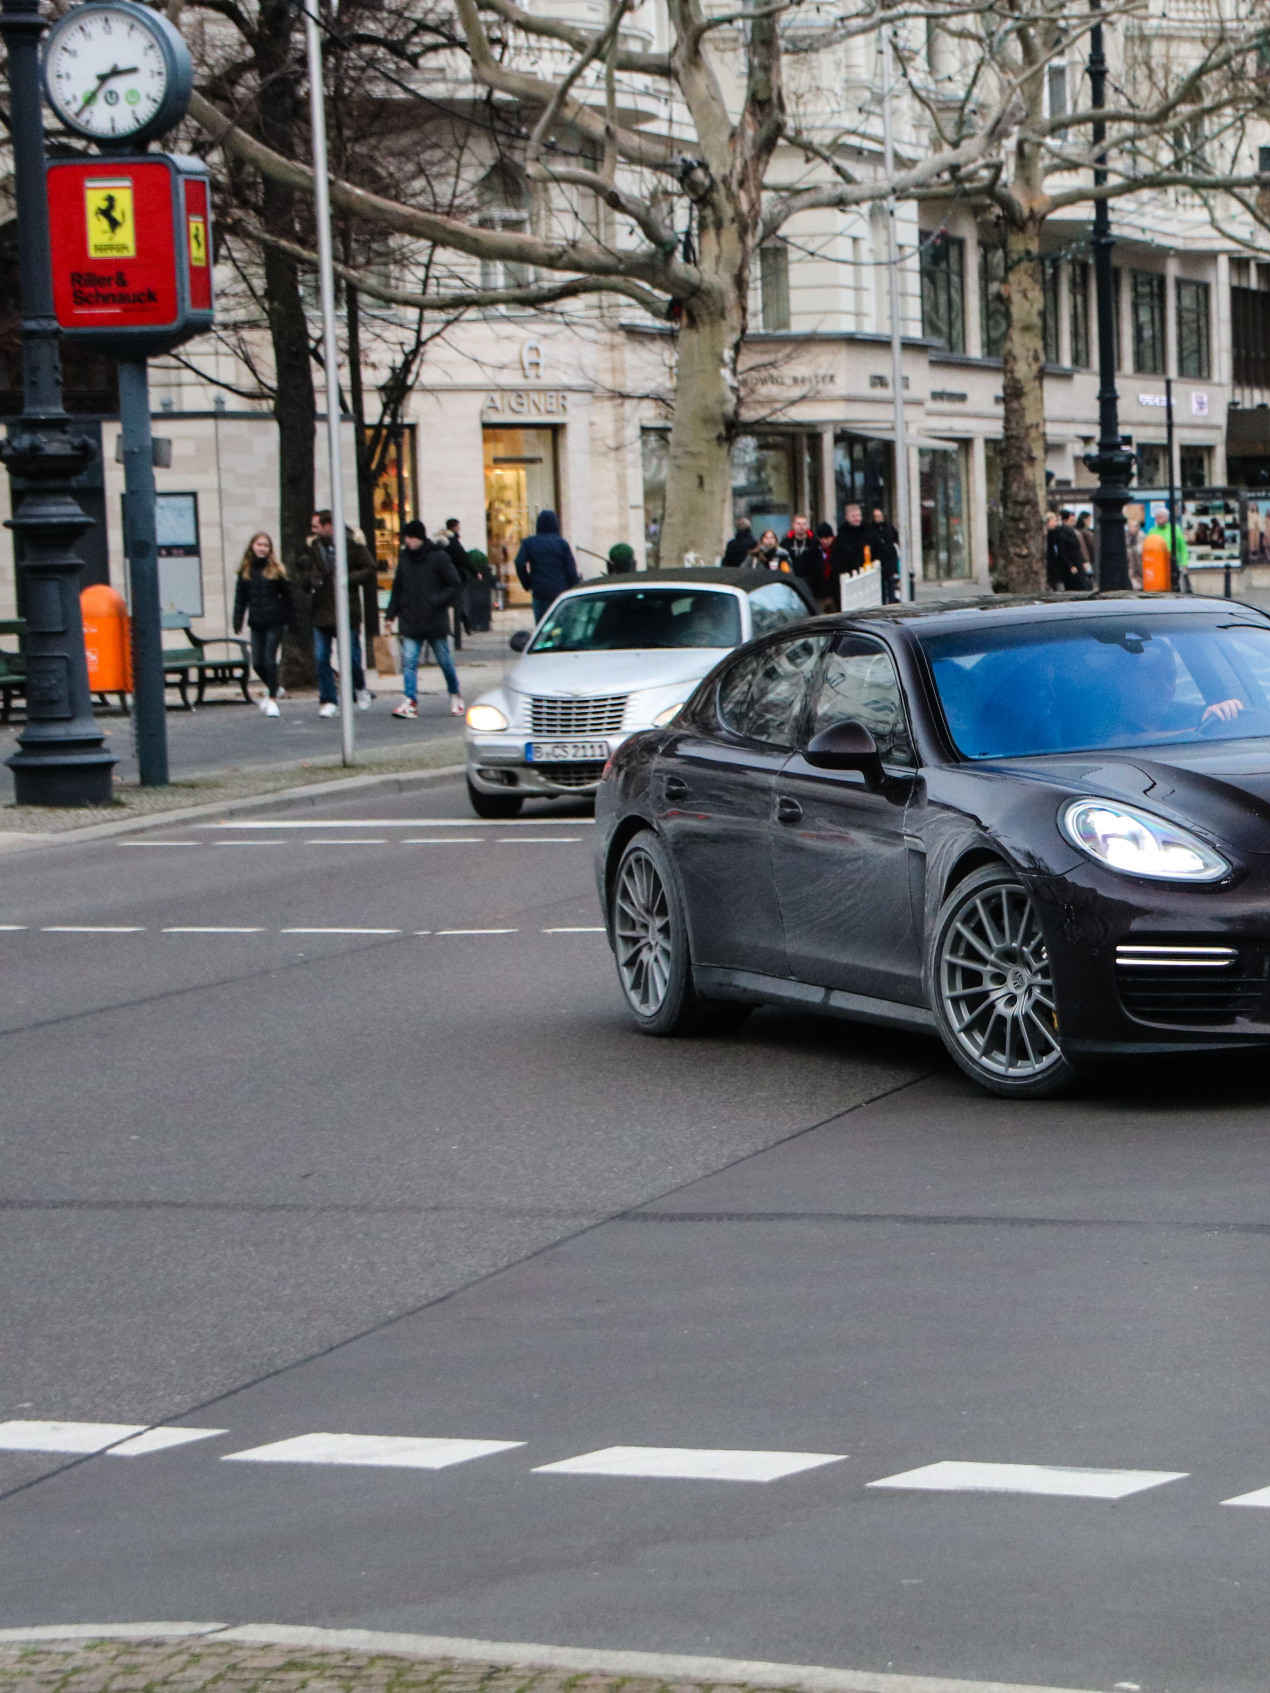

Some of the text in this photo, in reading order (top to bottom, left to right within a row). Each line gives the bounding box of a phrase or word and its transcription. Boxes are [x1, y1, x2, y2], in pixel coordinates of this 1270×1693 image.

[71, 271, 128, 287] Riller &
[73, 288, 158, 306] Schnauck
[484, 391, 568, 414] AIGNER
[572, 744, 605, 758] 2111
